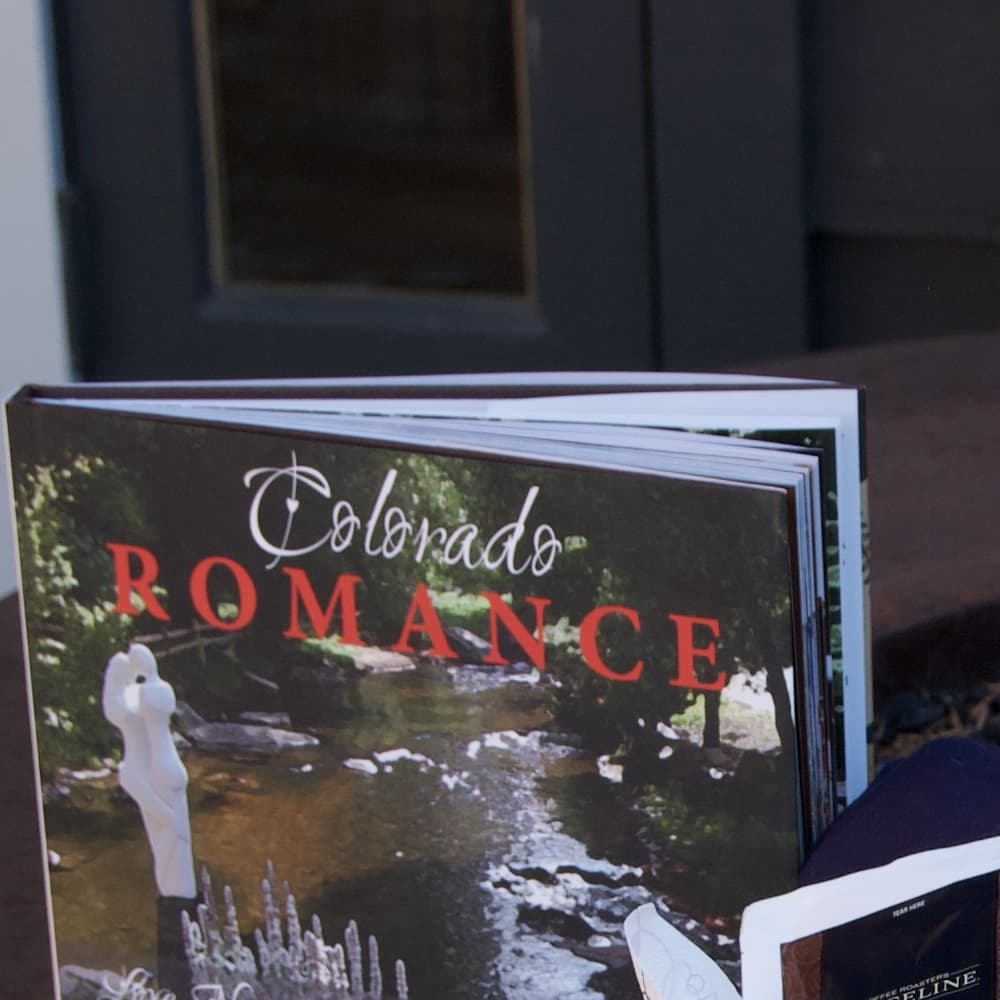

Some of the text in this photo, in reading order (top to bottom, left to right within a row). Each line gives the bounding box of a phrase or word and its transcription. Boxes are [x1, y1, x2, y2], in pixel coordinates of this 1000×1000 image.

[244, 450, 562, 577] Colorado
[105, 541, 728, 692] ROMANCE
[899, 972, 950, 994] ROASTERS
